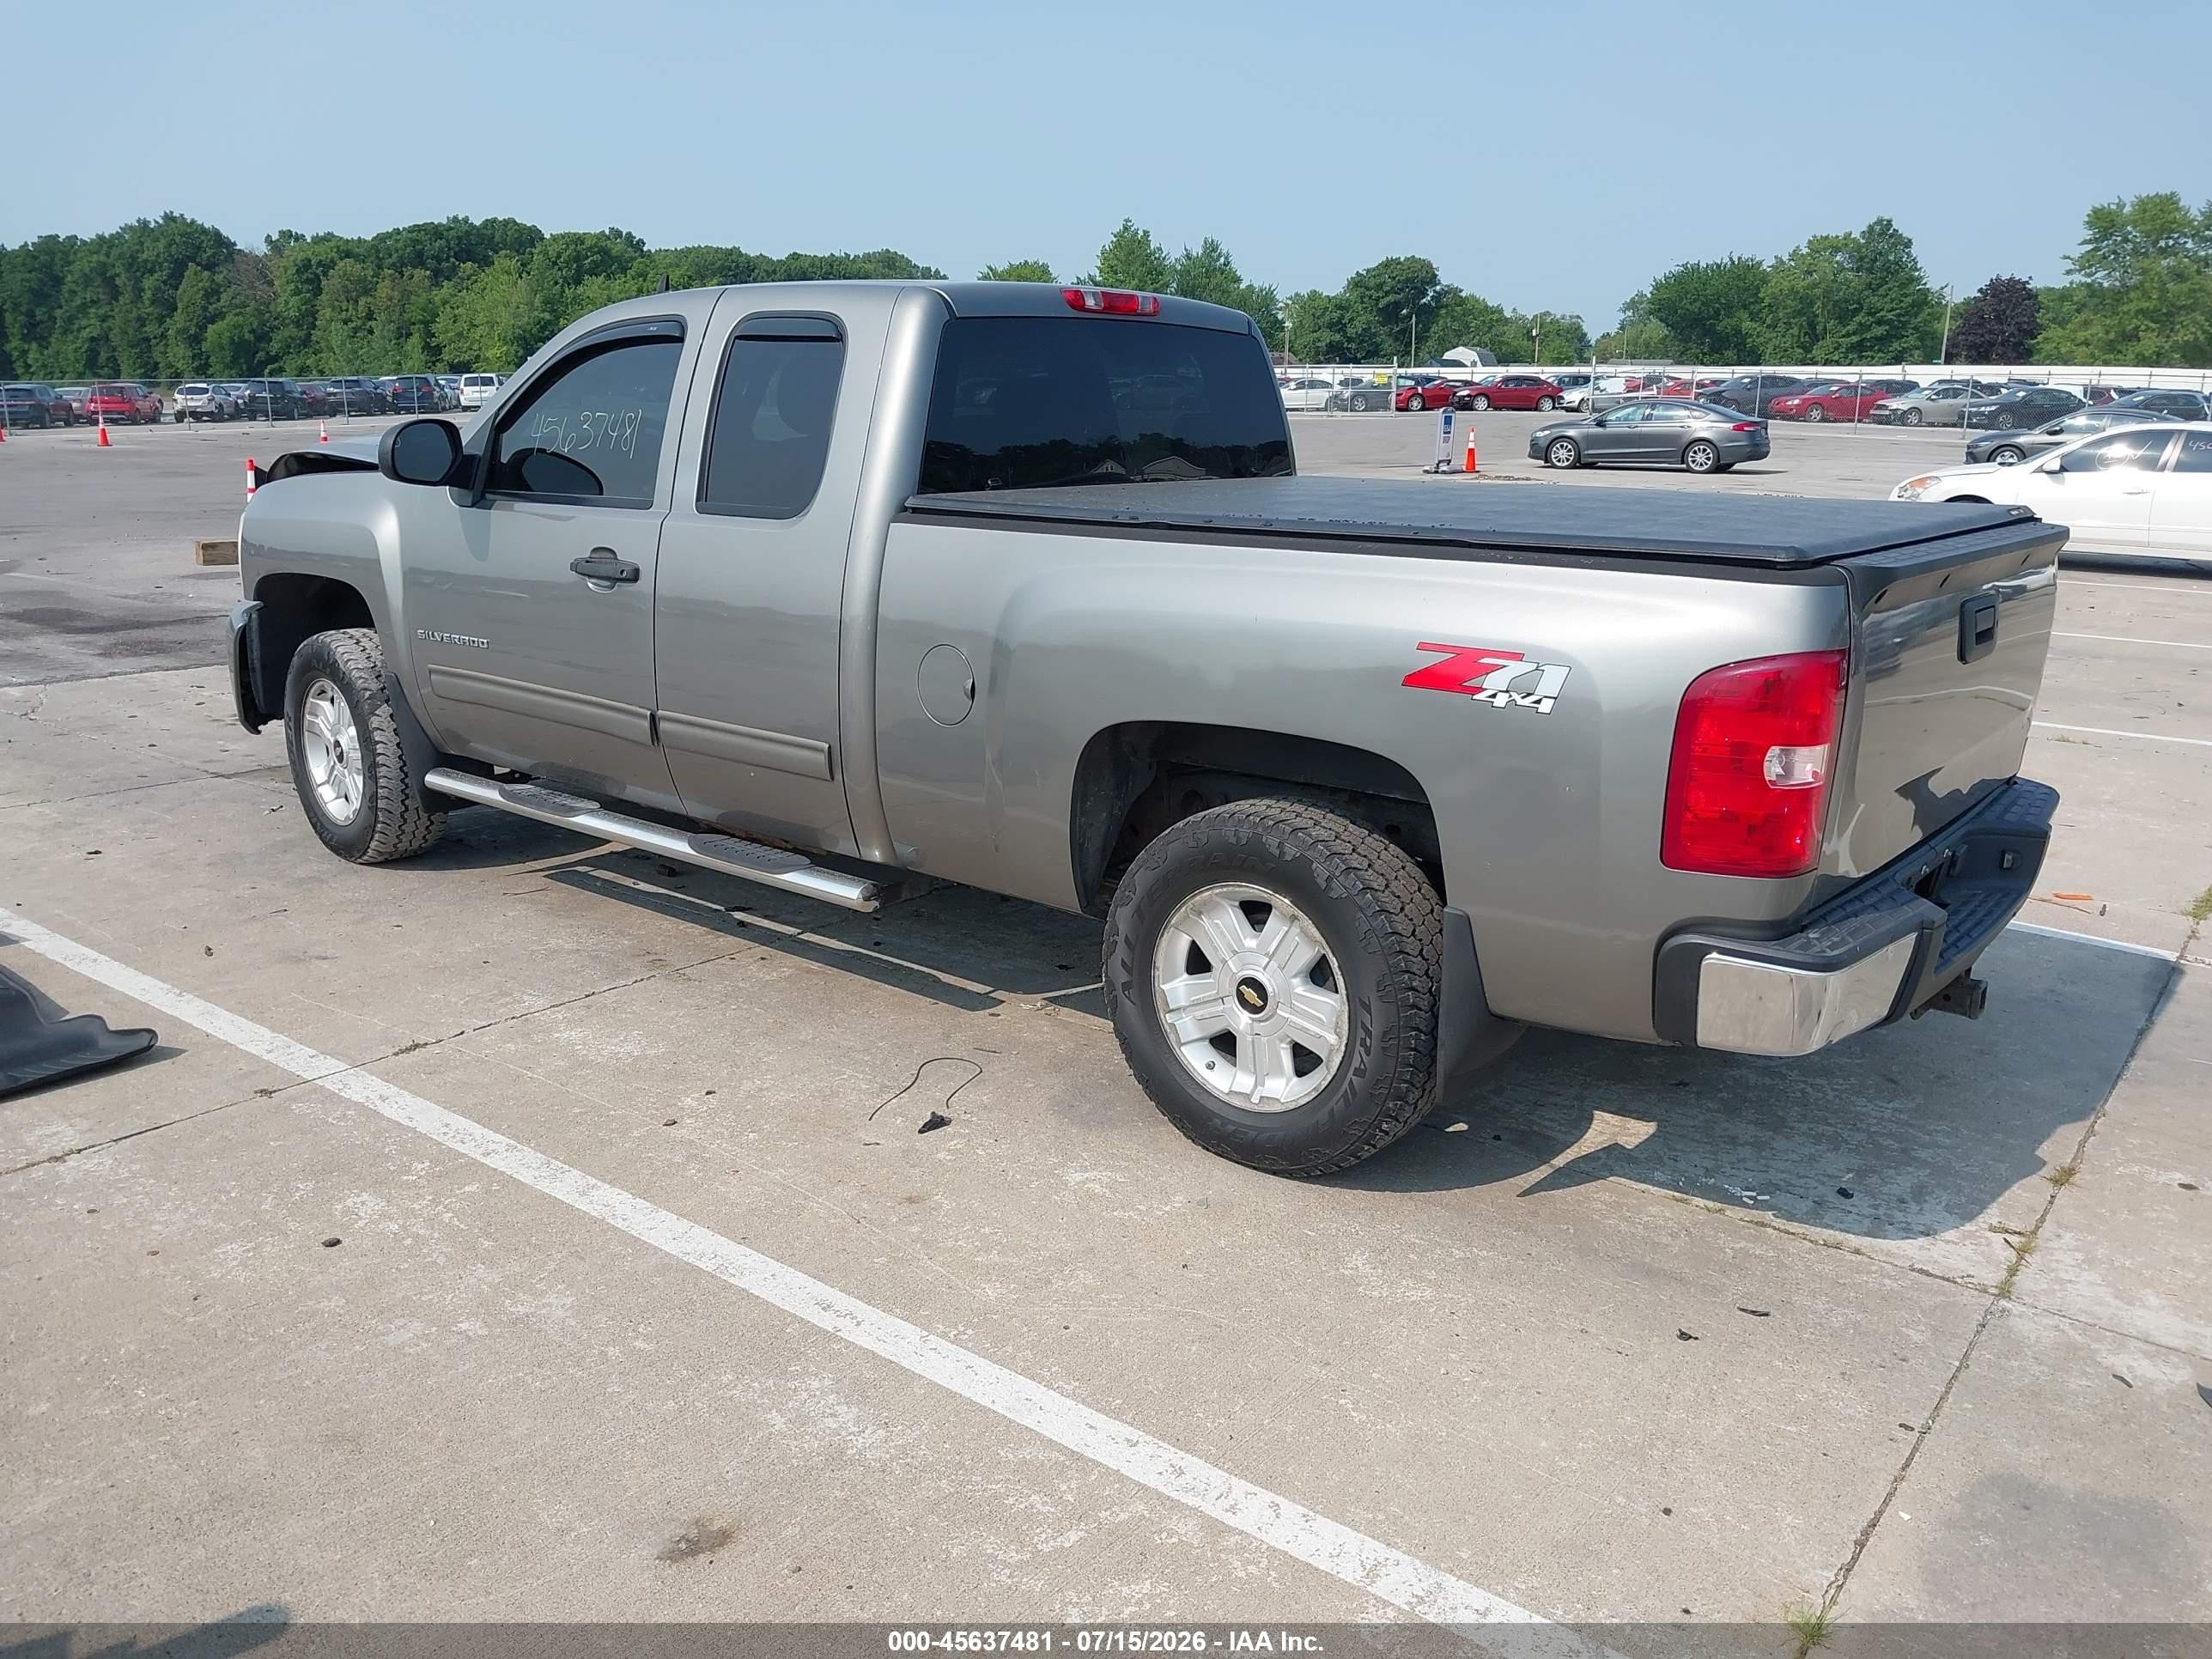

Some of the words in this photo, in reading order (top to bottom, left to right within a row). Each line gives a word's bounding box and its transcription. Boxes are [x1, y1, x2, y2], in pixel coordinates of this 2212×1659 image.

[530, 408, 643, 459] 45637481
[416, 629, 489, 649] SILVERADO
[1401, 641, 1572, 699] Z71
